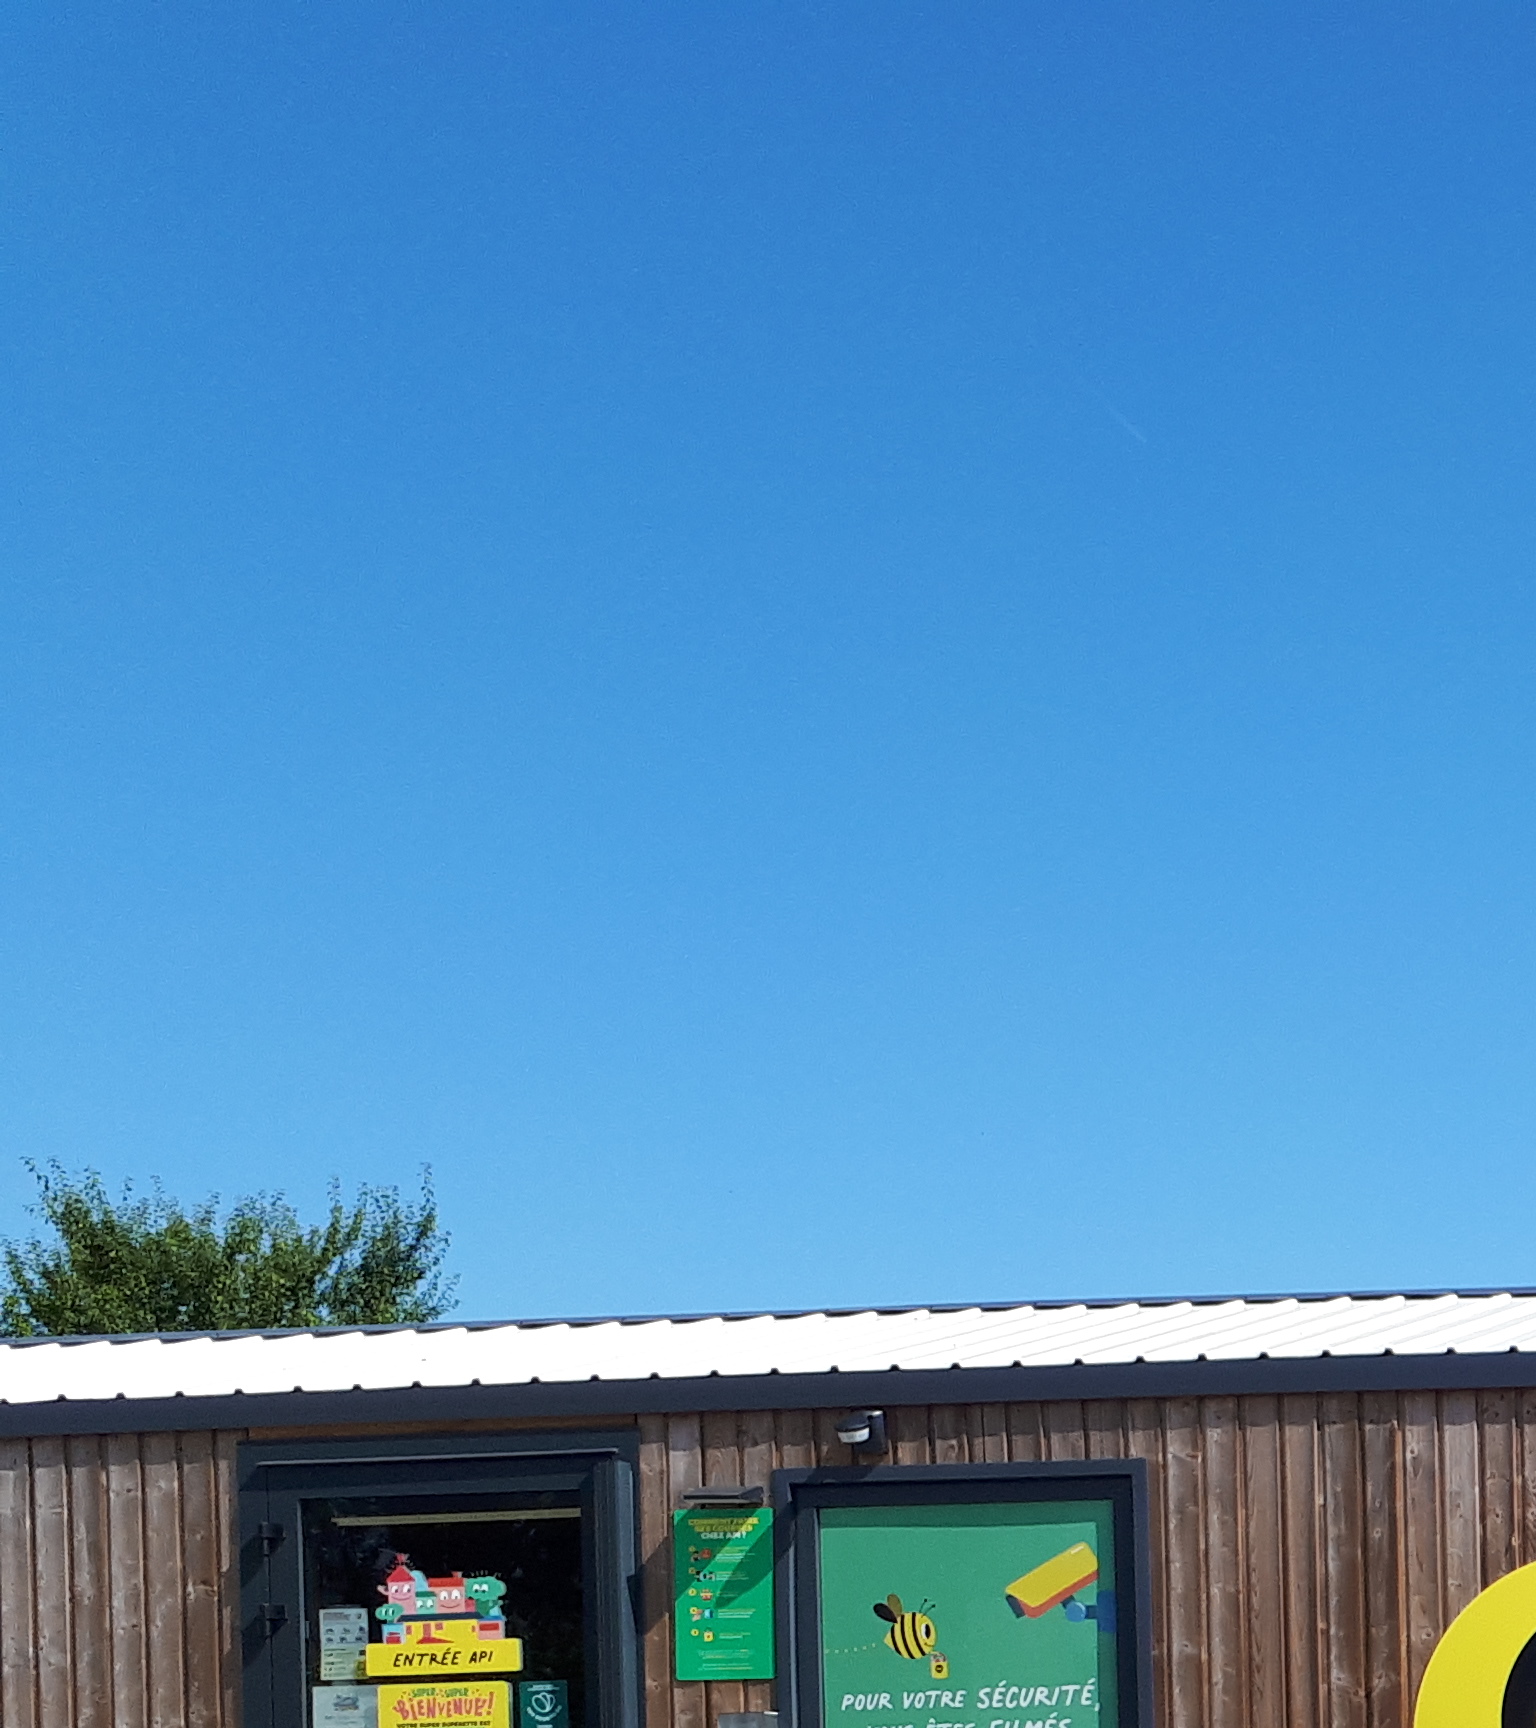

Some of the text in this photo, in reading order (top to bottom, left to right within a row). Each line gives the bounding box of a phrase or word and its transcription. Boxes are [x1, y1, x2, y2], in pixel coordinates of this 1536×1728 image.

[393, 1647, 494, 1668] ENTRÉE API
[841, 1677, 1100, 1712] POUR VOTRE SÉCURITÉ,
